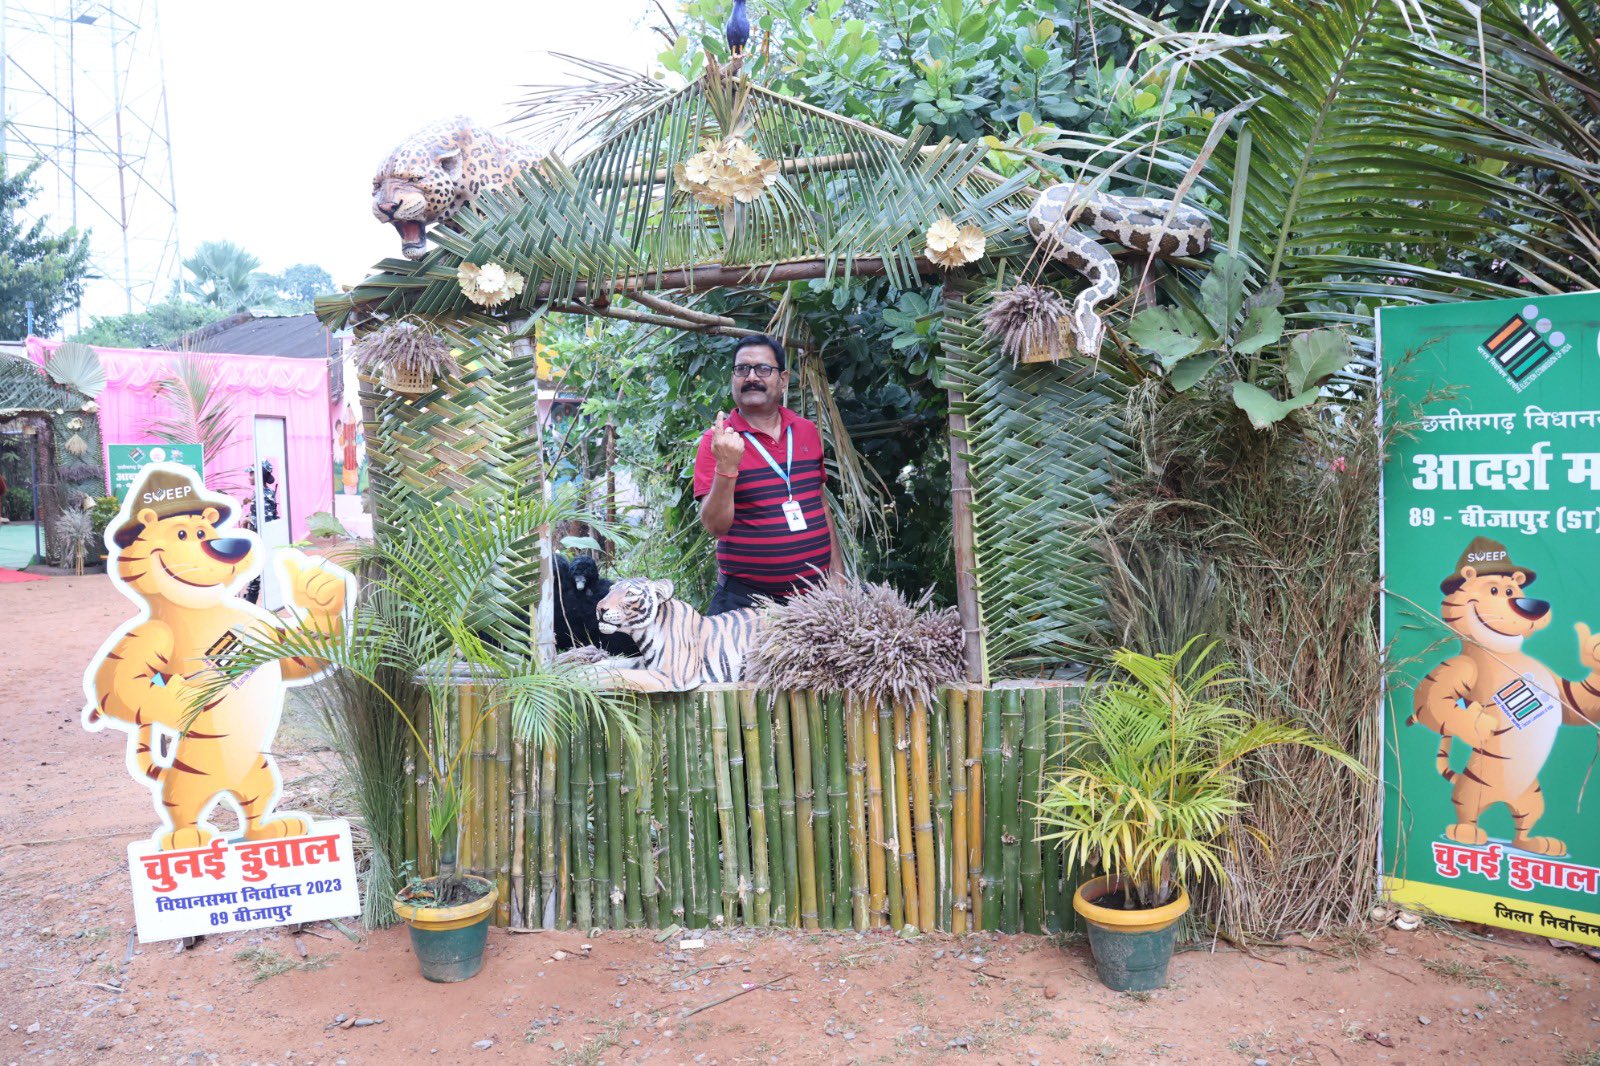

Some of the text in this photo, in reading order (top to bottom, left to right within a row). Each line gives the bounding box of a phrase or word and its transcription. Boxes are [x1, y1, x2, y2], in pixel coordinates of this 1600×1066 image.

[1421, 405, 1600, 435] छत्तीसगढ़ विधान
[1412, 441, 1553, 491] आदर्श
[143, 485, 192, 504] SWEEP
[1409, 506, 1435, 526] 89
[1458, 505, 1550, 535] बीजापुर
[1467, 551, 1507, 563] SWEEP
[140, 838, 228, 893] चुनई
[1433, 843, 1502, 879] चुनई
[240, 883, 302, 903] निर्वाचन
[306, 878, 342, 895] 2023
[210, 904, 293, 926] 89 बीजापुर
[1494, 902, 1534, 925] जिला
